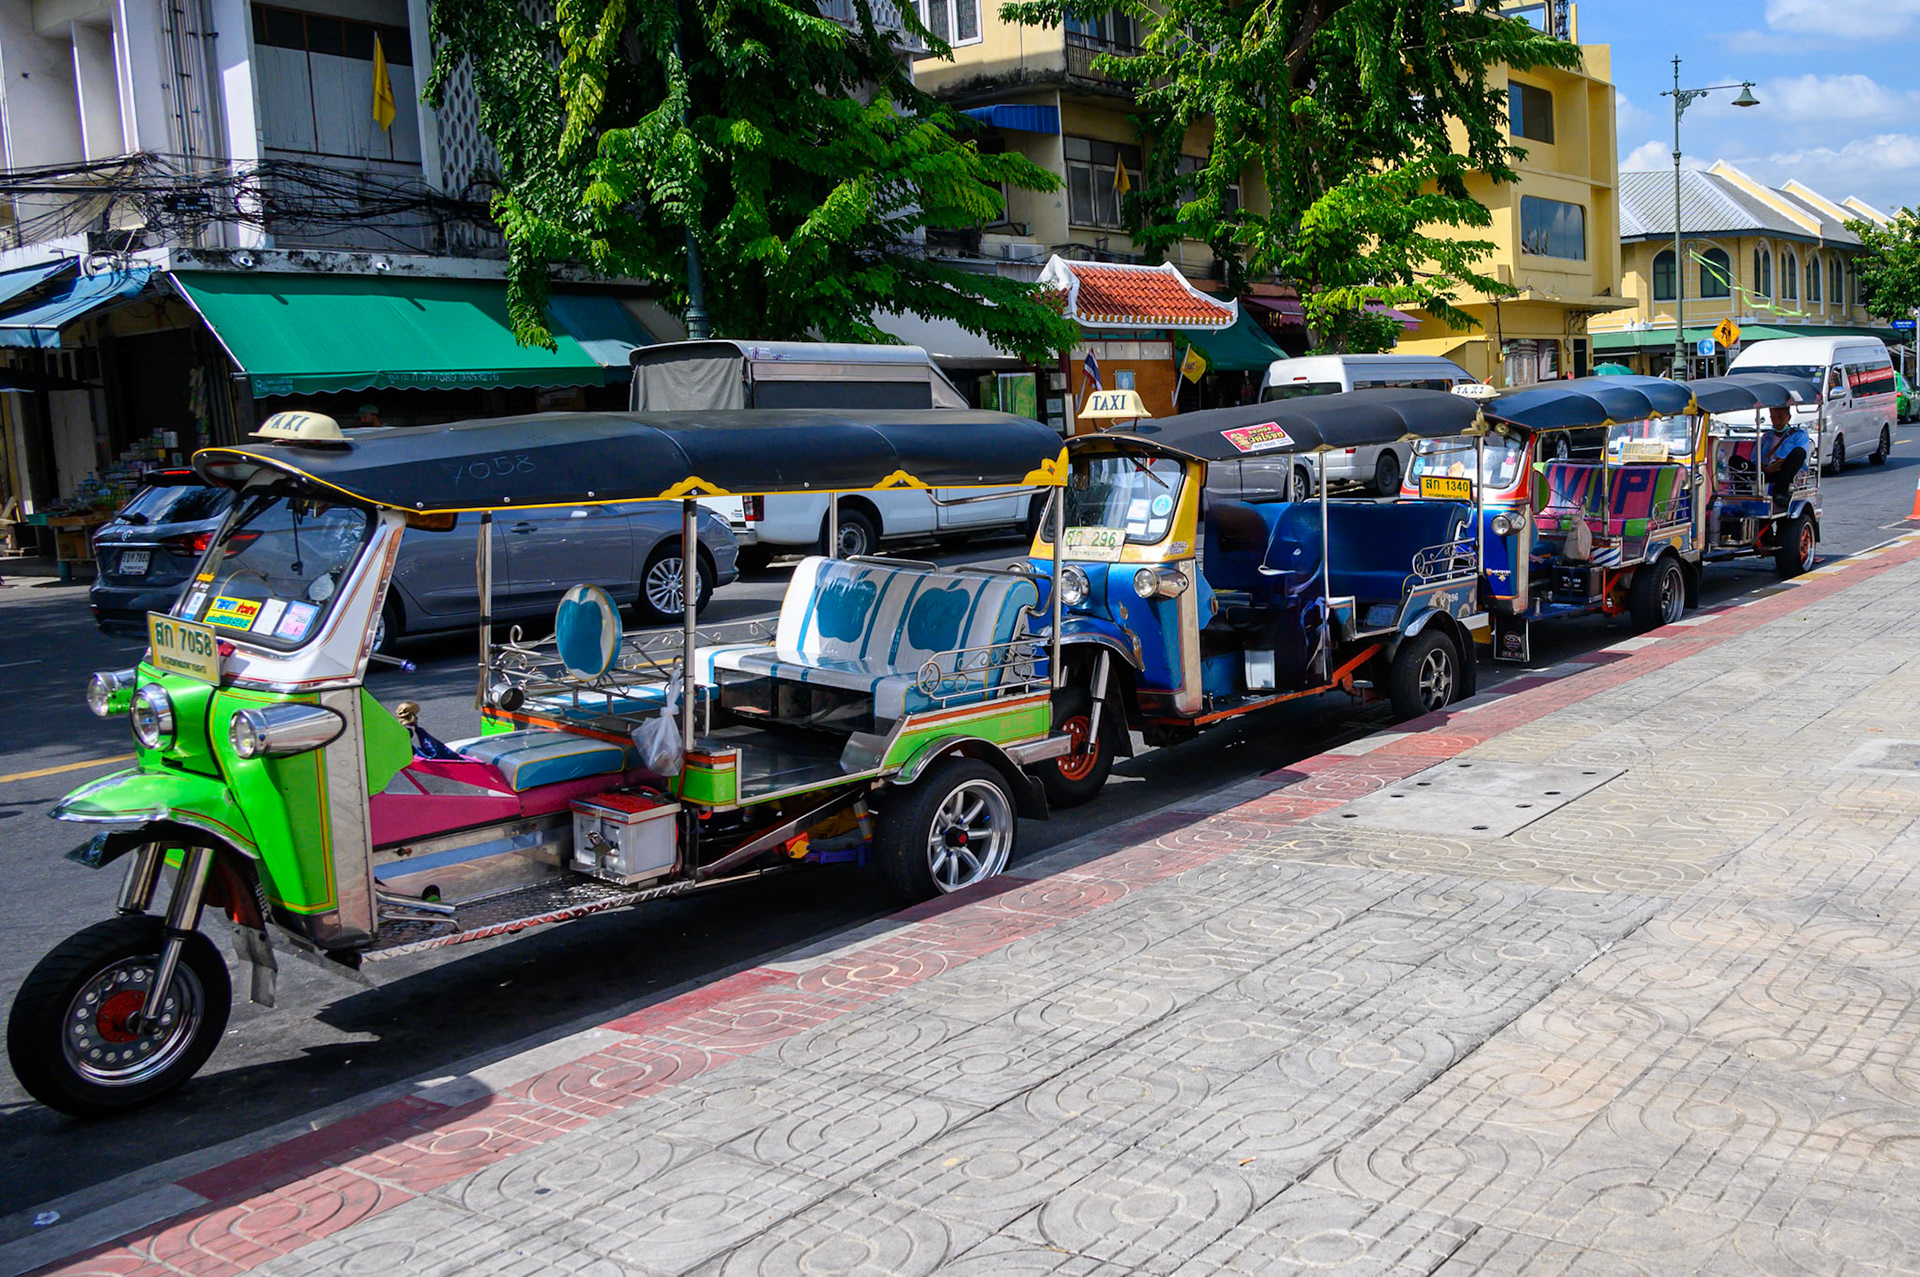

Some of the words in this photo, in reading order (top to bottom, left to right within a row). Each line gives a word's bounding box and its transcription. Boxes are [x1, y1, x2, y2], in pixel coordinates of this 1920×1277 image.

[1457, 386, 1484, 394] TAXI
[1093, 395, 1127, 411] TAXI
[267, 413, 310, 432] TAXI
[445, 454, 537, 486] 7058
[1426, 478, 1440, 490] สก
[1446, 480, 1468, 492] 1340
[1554, 466, 1652, 515] VIP
[1091, 531, 1117, 547] 296
[155, 621, 174, 649] สก
[179, 626, 212, 657] 7058
